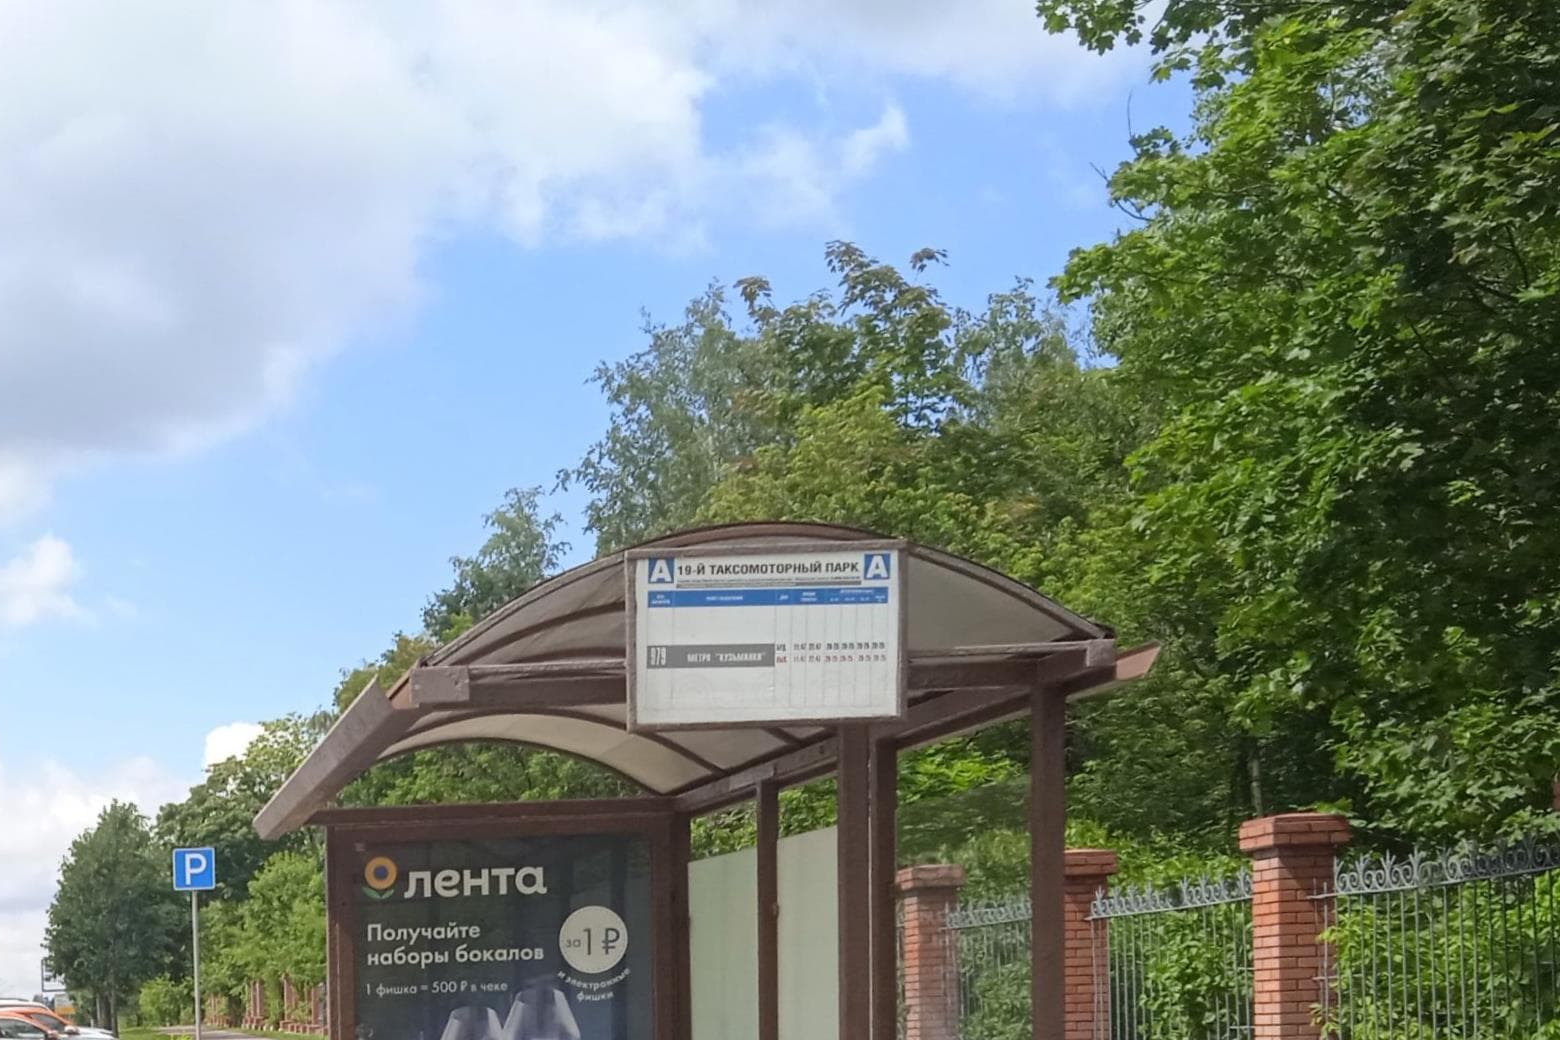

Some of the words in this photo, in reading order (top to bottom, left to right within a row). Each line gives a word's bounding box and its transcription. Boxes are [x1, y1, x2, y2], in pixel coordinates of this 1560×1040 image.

[677, 563, 706, 576] 19-Й
[709, 561, 822, 576] ТАКСОМОТОРНЫЙ
[825, 561, 859, 573] ПАРК
[185, 853, 206, 885] P
[403, 865, 547, 898] лента
[367, 922, 481, 945] Получайте
[566, 938, 581, 948] за
[583, 927, 592, 956] 1
[367, 950, 449, 968] наборы
[455, 944, 544, 963] бокалов
[376, 982, 417, 997] фишка
[431, 981, 457, 994] 500
[480, 982, 508, 992] чеке
